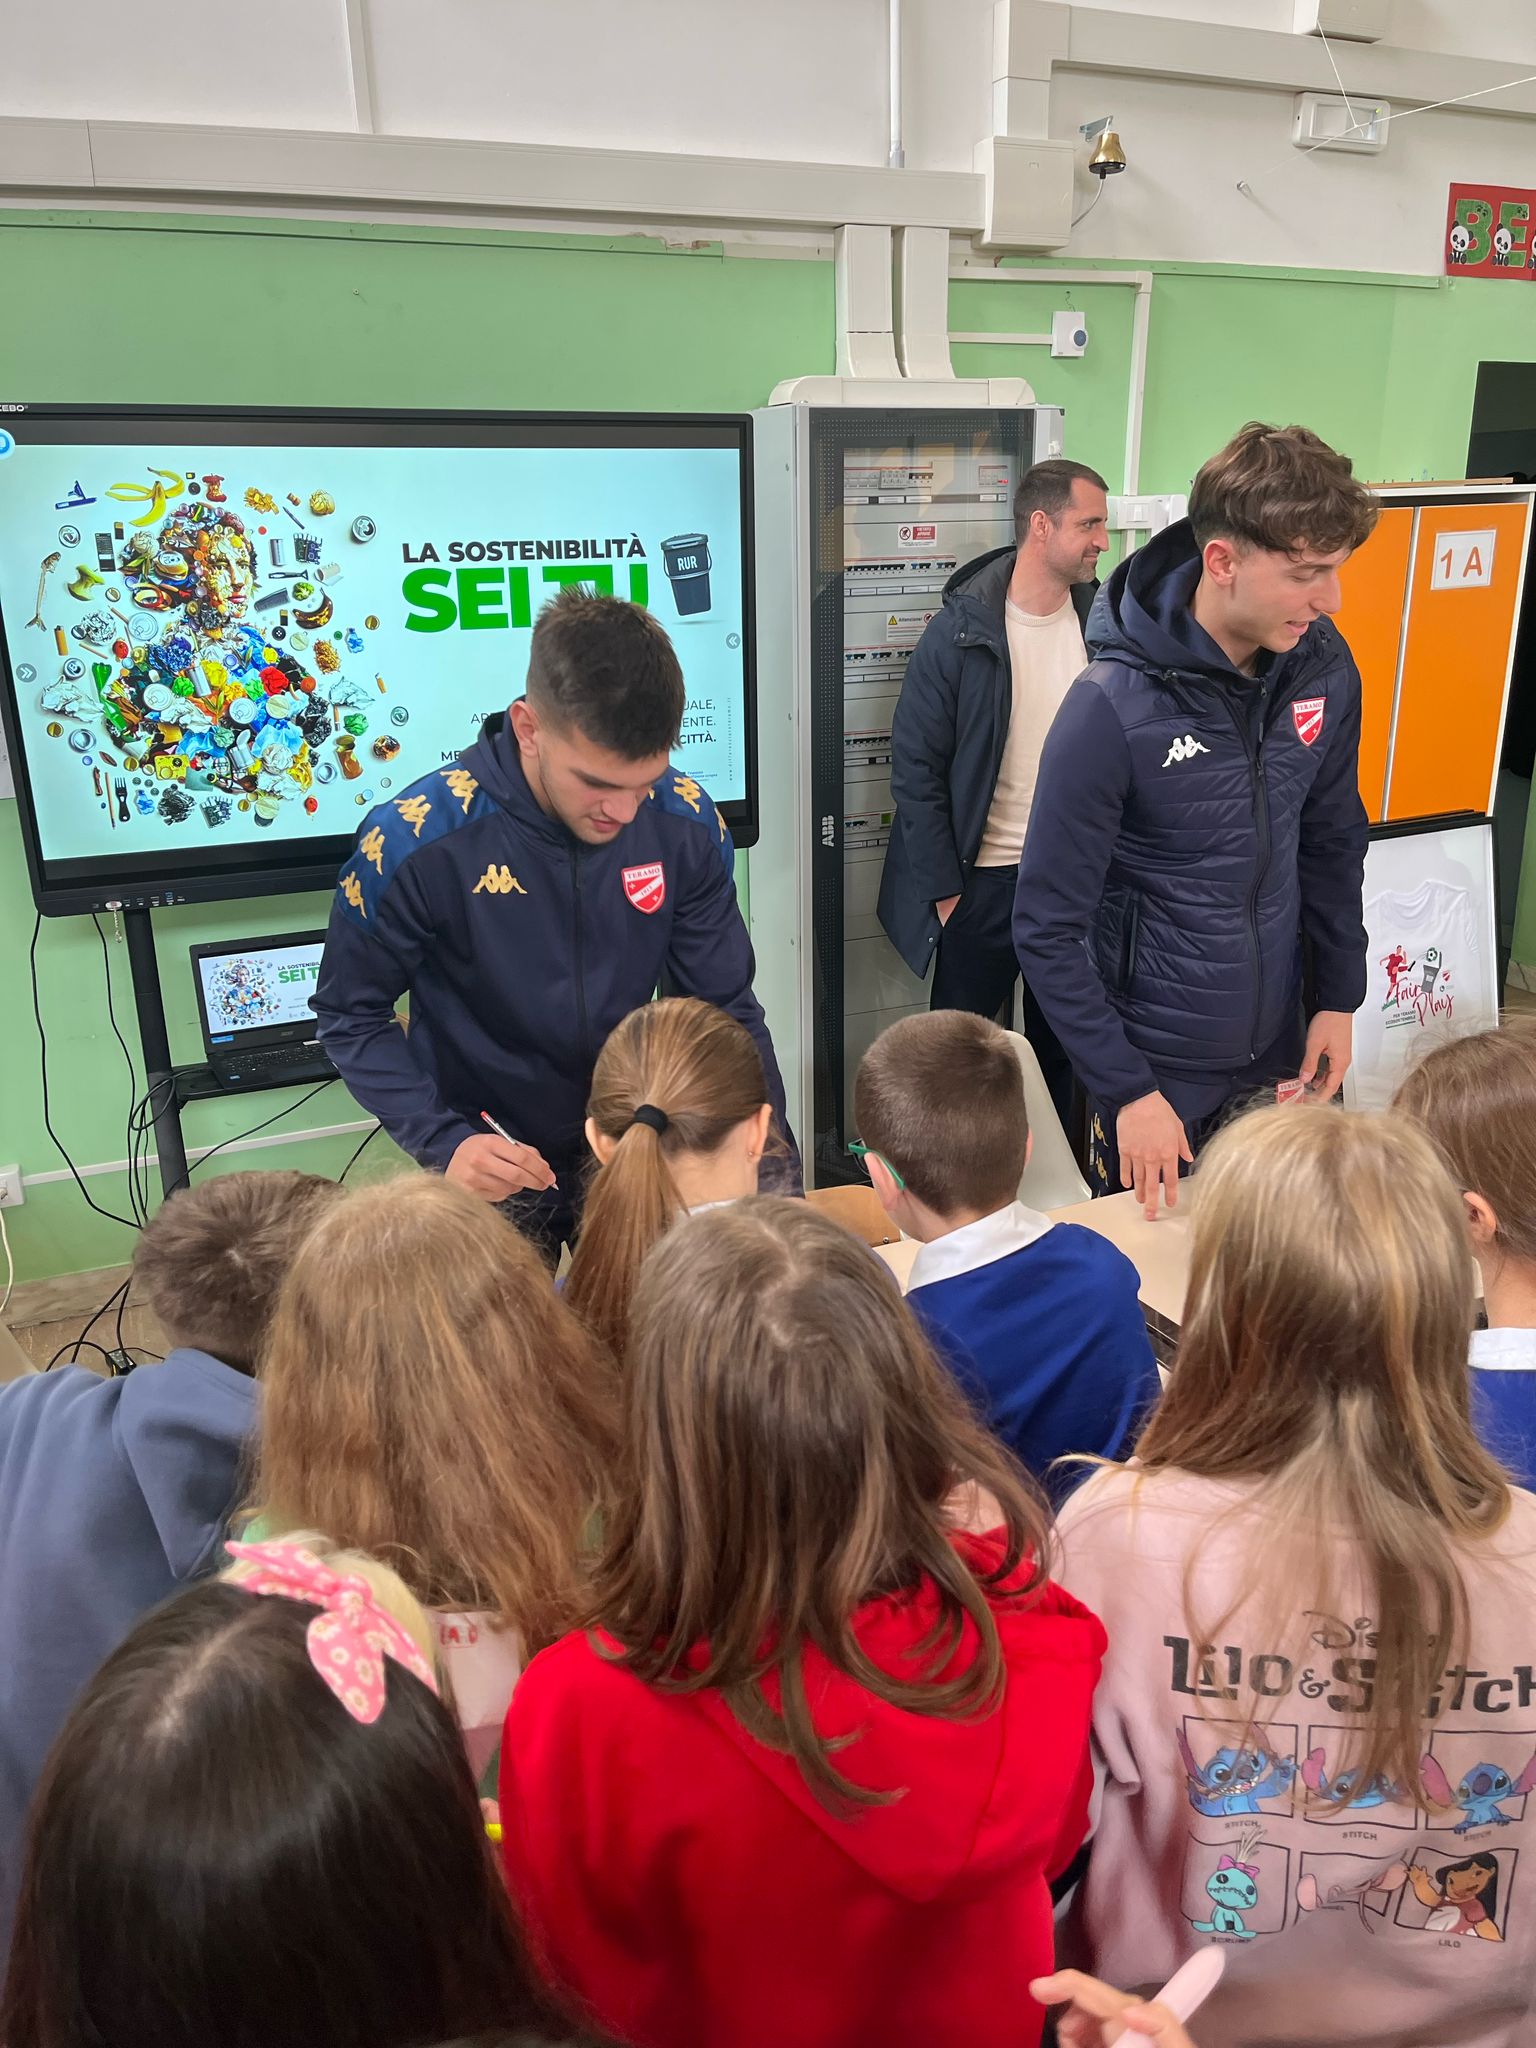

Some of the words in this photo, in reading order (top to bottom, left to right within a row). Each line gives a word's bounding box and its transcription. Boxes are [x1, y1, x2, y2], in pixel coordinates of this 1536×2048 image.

[0, 404, 25, 412] EBO
[402, 542, 440, 563] LA
[448, 533, 647, 562] SOSTENIBILITÀ
[677, 555, 698, 571] RUR
[402, 566, 532, 633] SEI
[1296, 702, 1322, 711] TERAMO
[679, 730, 717, 744] CITTÀ.
[822, 815, 835, 847] ABB
[628, 868, 660, 879] TERAMO
[278, 968, 306, 984] SEI
[1396, 977, 1422, 1008] Fair
[1412, 991, 1454, 1026] Play
[1280, 1080, 1302, 1090] TERAM
[1342, 1831, 1377, 1841] STITCH
[1438, 1939, 1461, 1949] LILO
